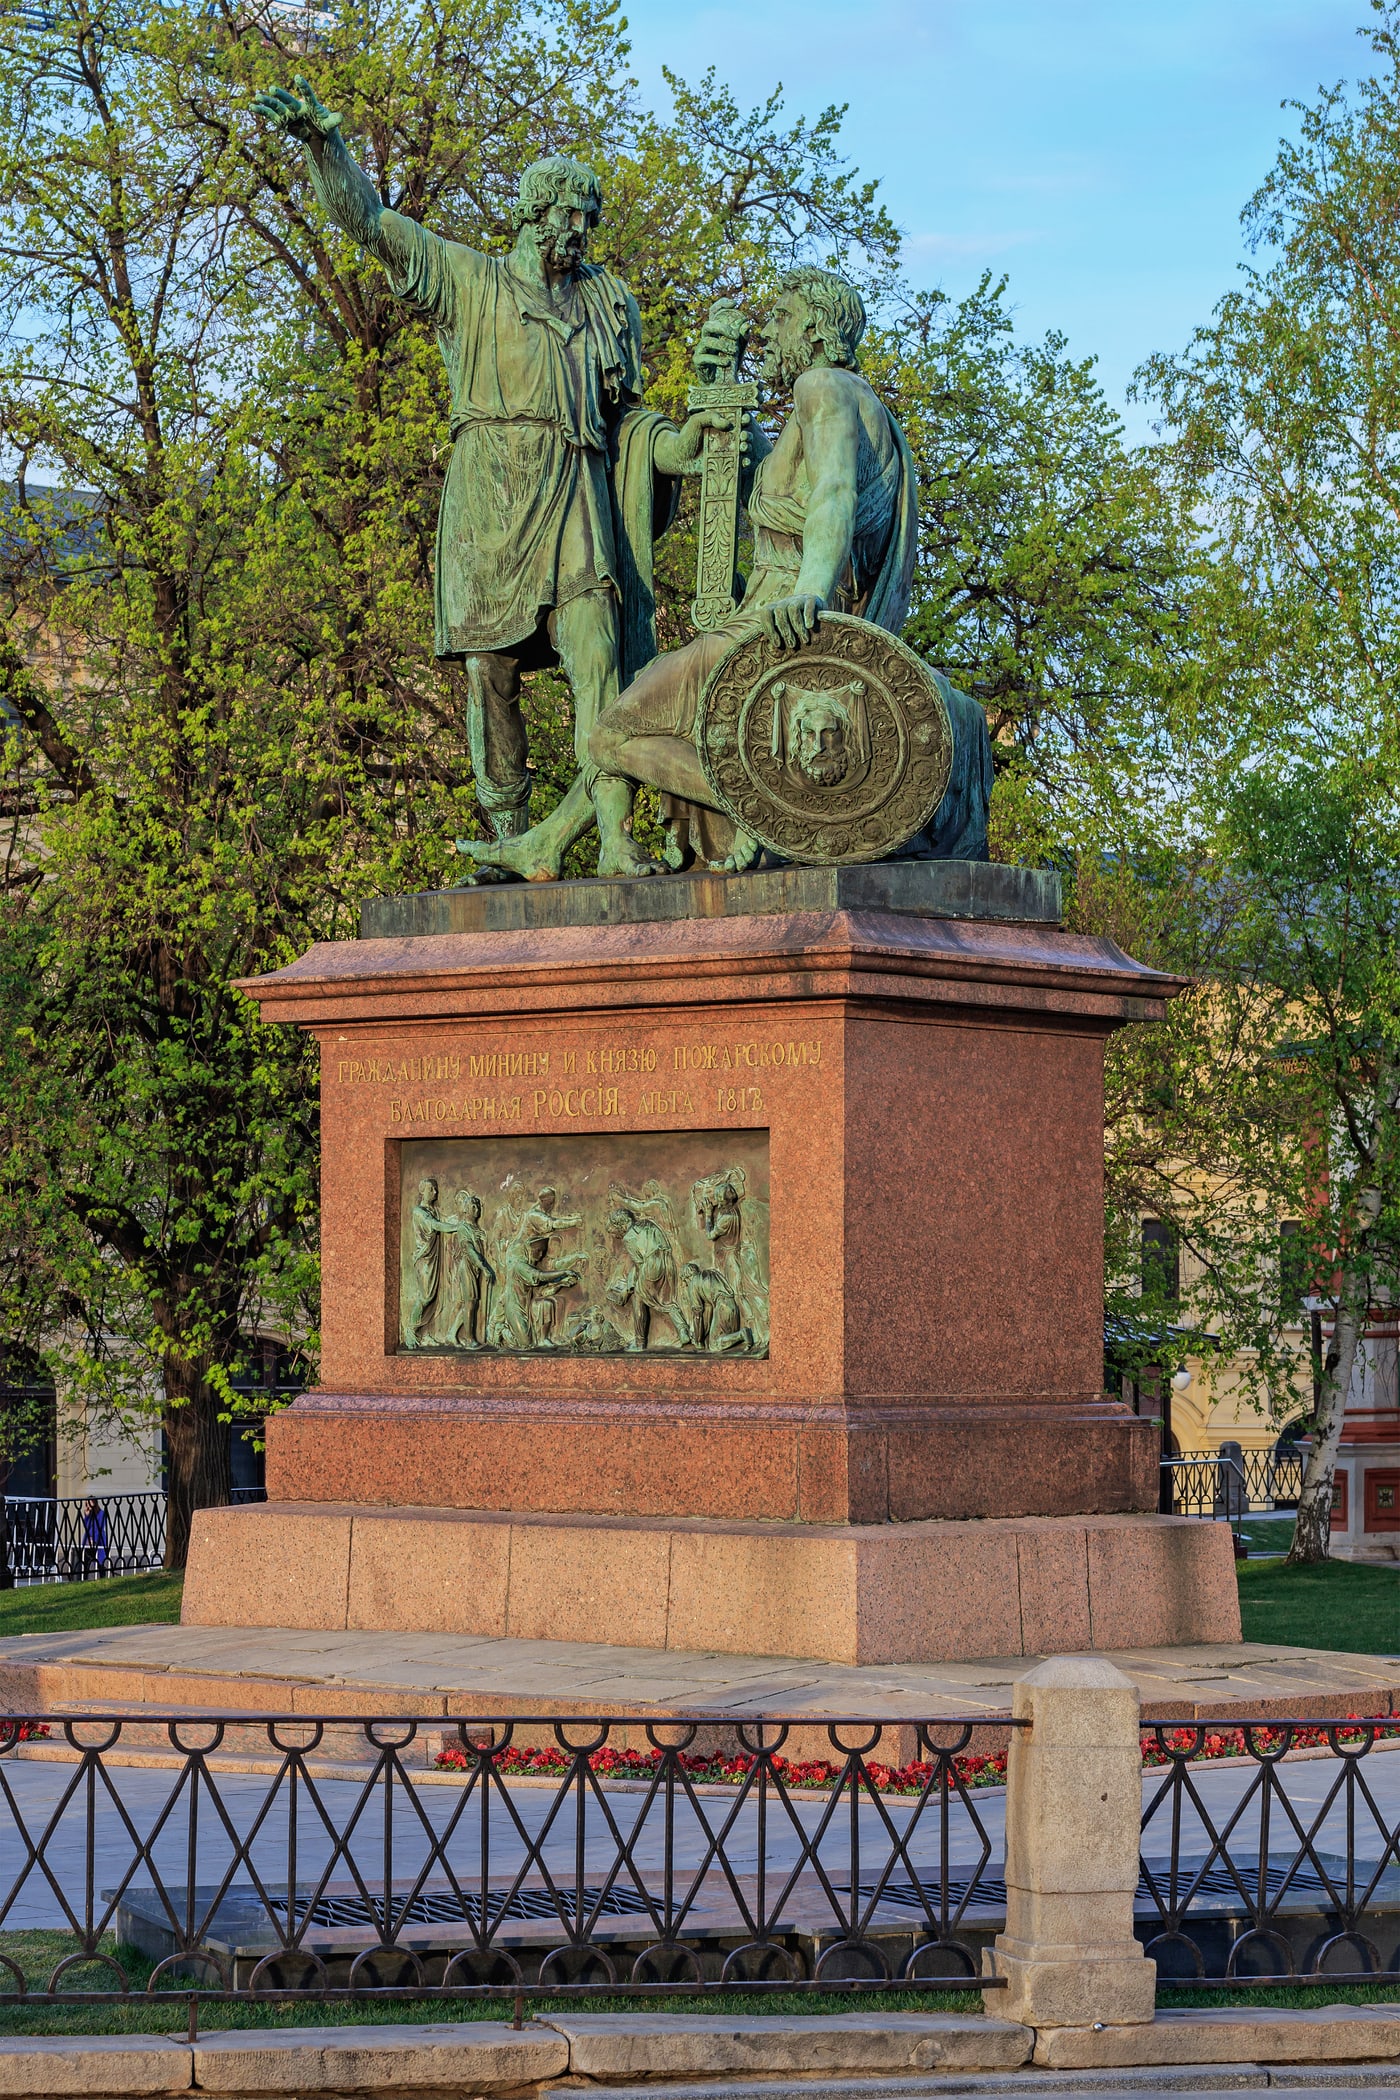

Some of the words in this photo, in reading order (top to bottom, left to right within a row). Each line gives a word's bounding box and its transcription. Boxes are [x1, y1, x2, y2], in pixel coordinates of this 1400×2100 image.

[470, 1052, 550, 1077] МИНИНУ
[563, 1051, 577, 1075] И
[586, 1048, 658, 1073] КНЯЗЮ
[674, 1041, 823, 1070] ПОЖАРСКОМУ
[390, 1097, 522, 1122] БЛАГОДАРНАЯ
